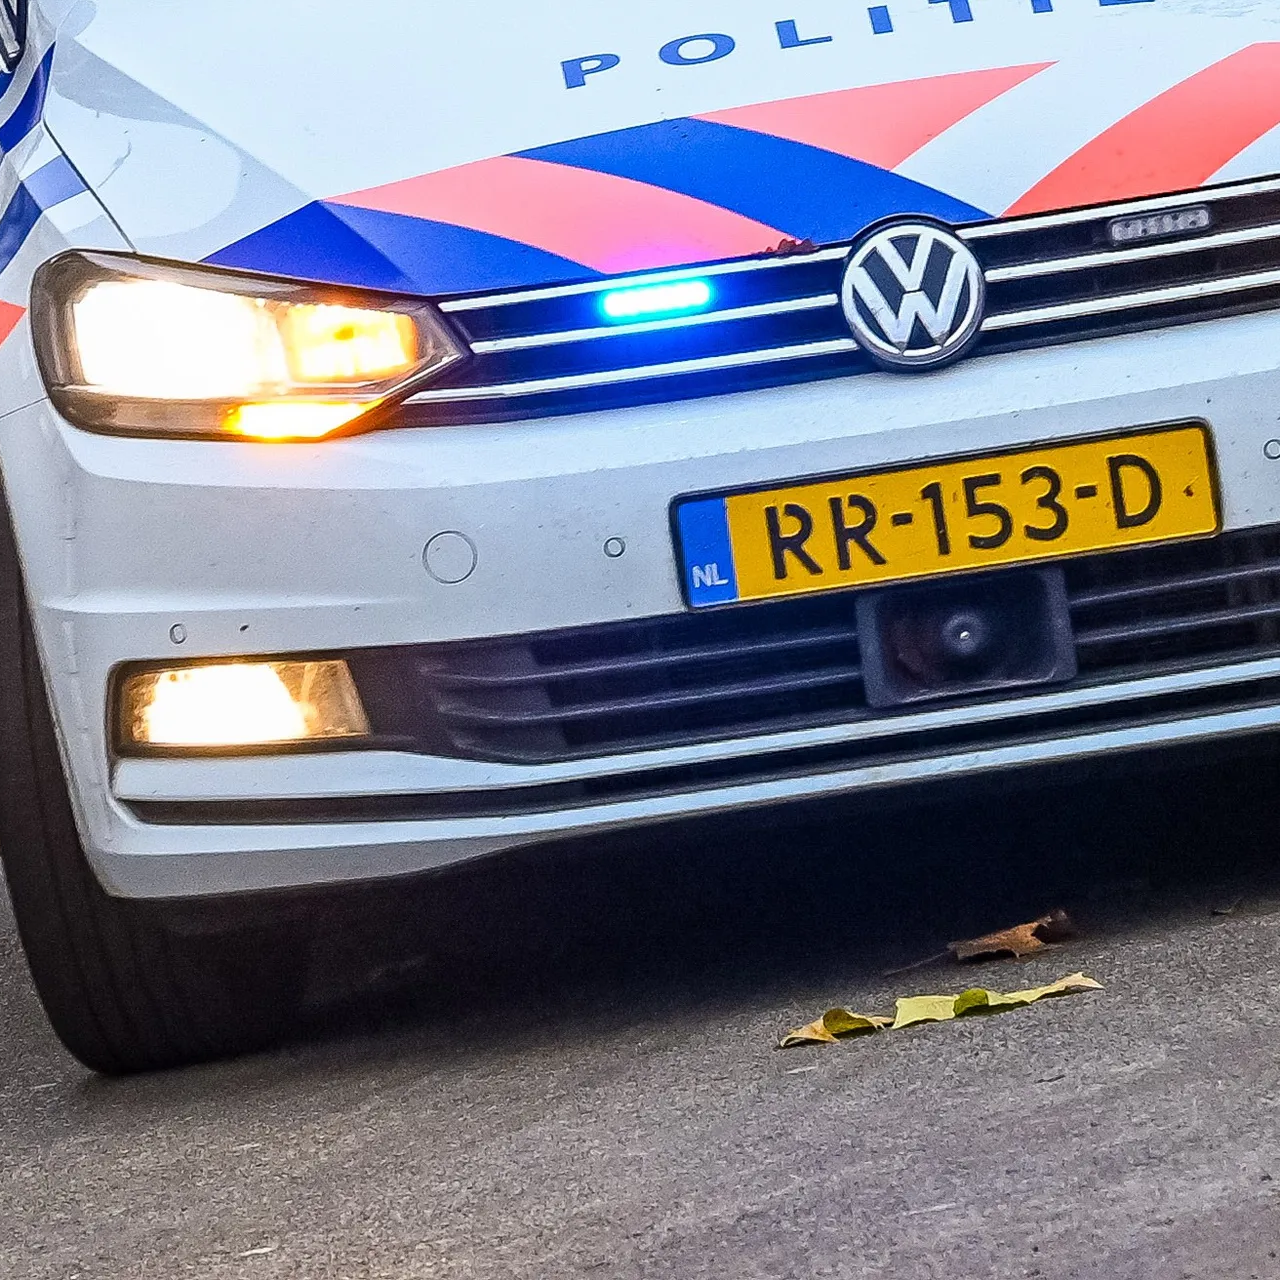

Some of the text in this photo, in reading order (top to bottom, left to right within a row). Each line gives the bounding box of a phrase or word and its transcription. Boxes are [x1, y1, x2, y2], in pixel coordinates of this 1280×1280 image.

[845, 226, 981, 360] VW
[692, 562, 729, 588] NL
[764, 453, 1163, 580] RR-153-D
